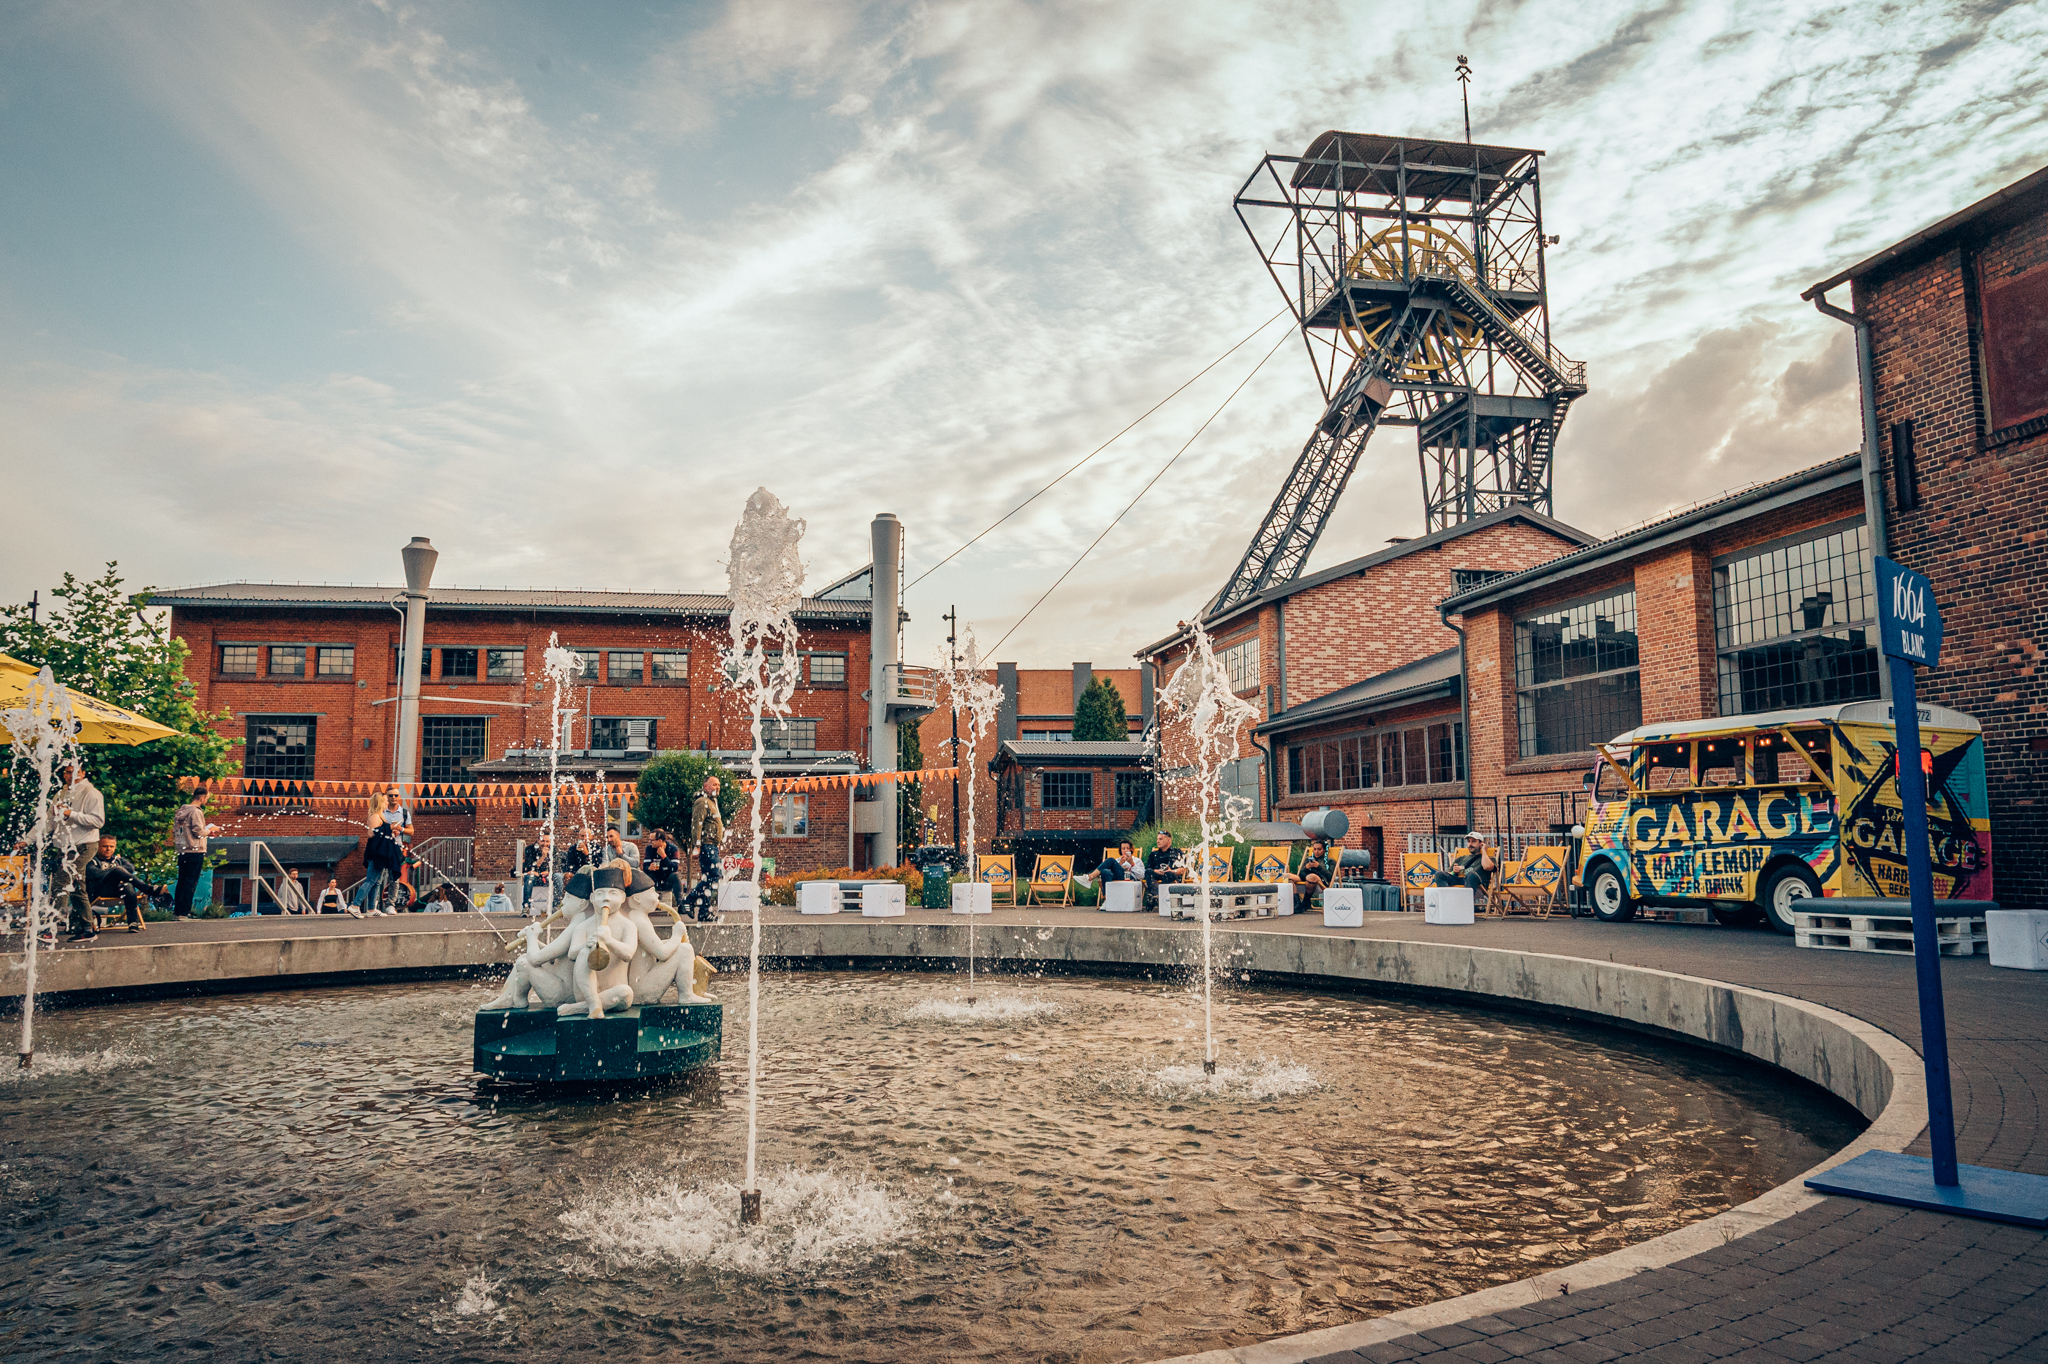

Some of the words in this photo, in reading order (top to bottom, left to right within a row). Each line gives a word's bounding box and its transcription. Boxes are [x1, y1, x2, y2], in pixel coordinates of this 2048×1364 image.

[1893, 571, 1926, 628] 1664
[1901, 630, 1926, 659] BLANC
[1591, 822, 1623, 834] GARAGE
[1631, 791, 1834, 851] GARAGE
[1527, 870, 1560, 878] GARAGE
[1653, 853, 1694, 880] HARD
[1702, 847, 1764, 876] LEMON
[1878, 863, 1908, 884] HARD
[1888, 883, 1910, 898] BEER
